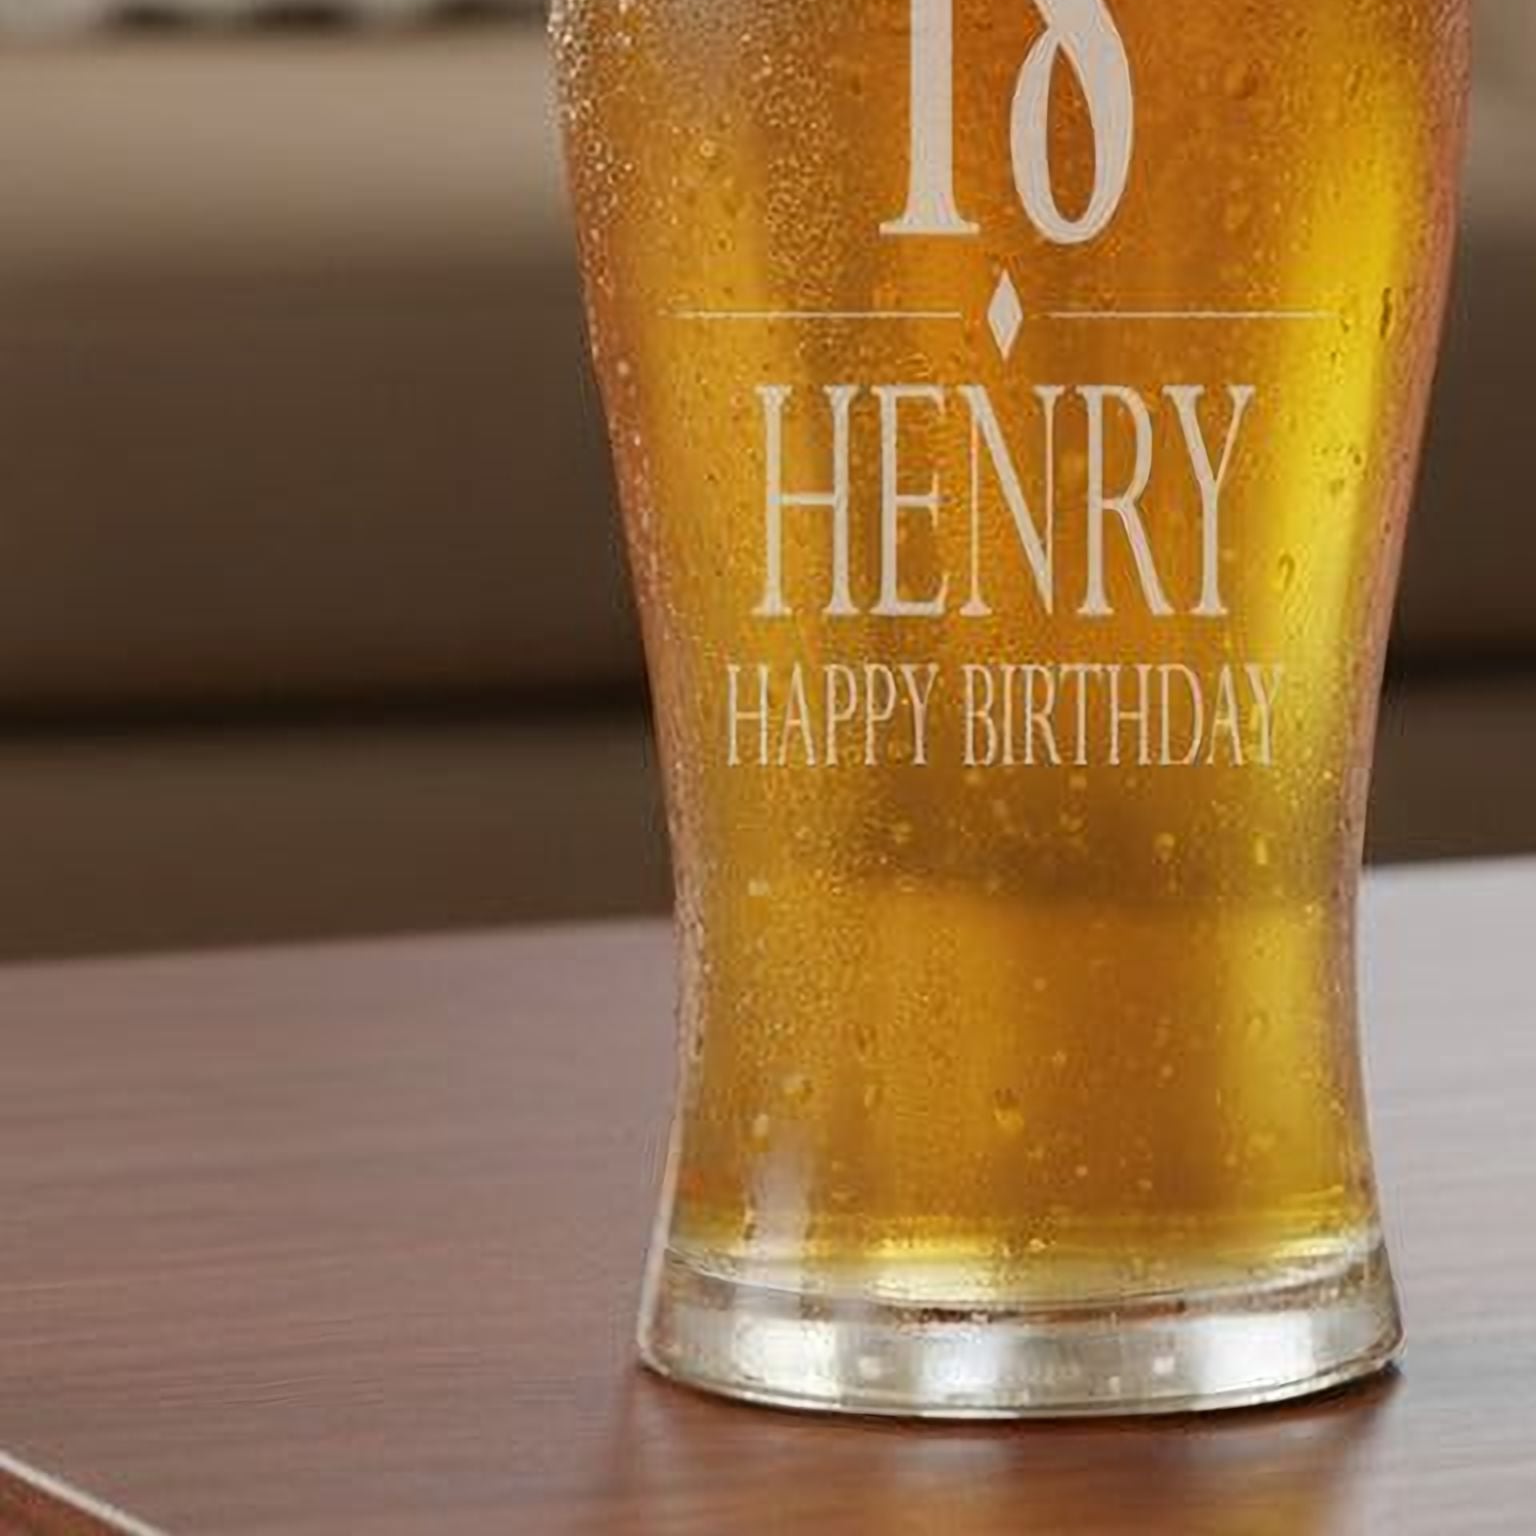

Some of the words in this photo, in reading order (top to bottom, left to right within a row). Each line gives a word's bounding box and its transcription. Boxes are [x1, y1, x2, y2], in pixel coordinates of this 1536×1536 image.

[751, 383, 1255, 618] HENRY
[725, 663, 940, 766] HAPPY
[963, 663, 1284, 766] BIRTHDAY
